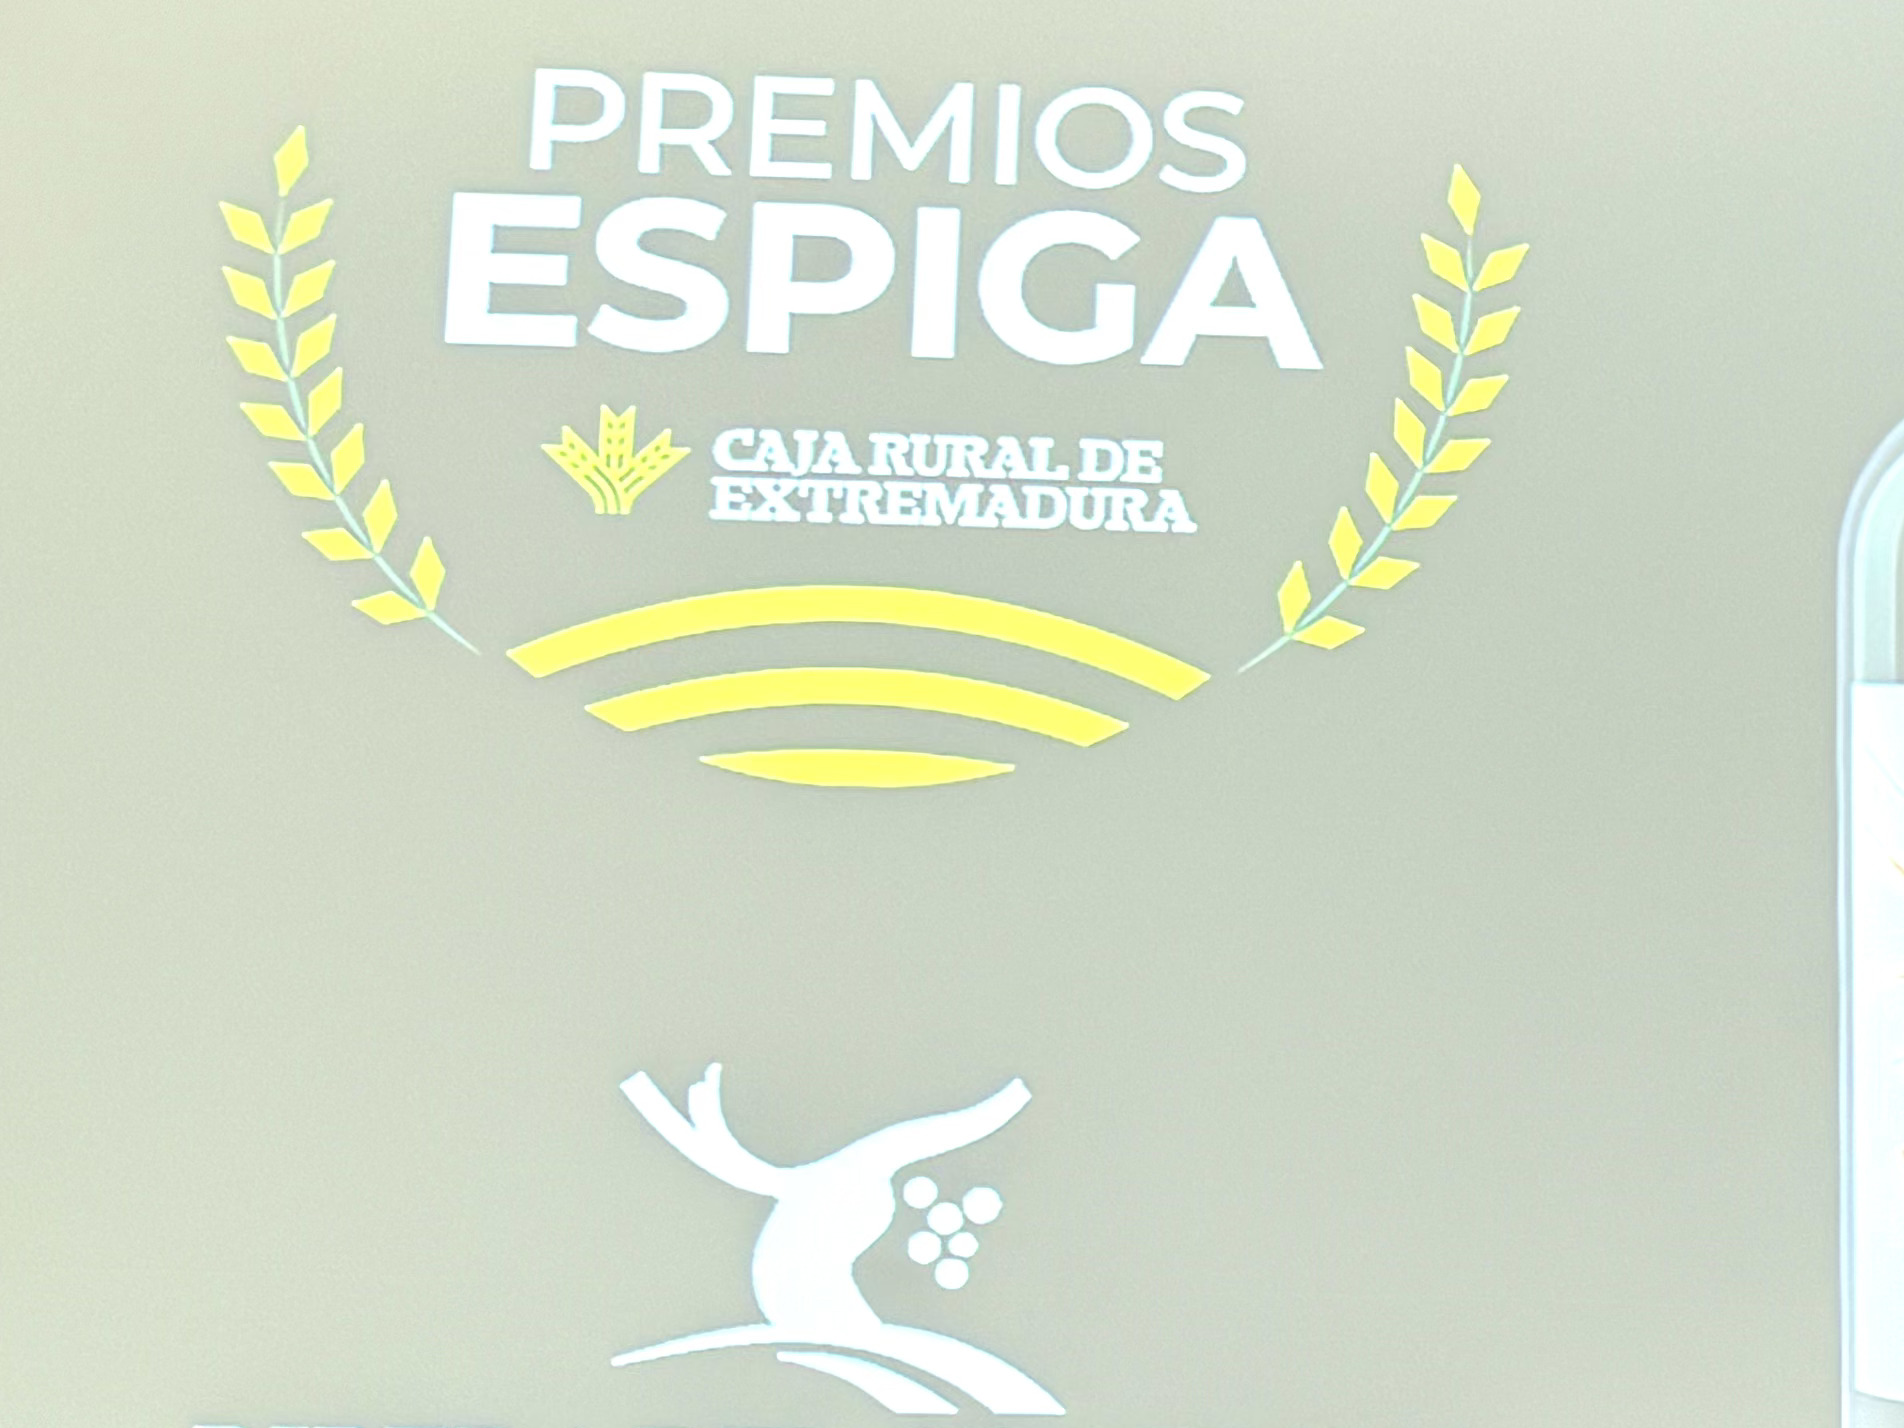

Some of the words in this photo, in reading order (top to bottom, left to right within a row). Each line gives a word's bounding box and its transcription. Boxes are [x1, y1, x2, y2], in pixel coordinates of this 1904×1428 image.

[530, 69, 1245, 192] PREMIOS
[443, 190, 1323, 370] ESPIGA
[711, 428, 862, 478] CAJA
[867, 432, 1070, 482] RURAL
[1077, 438, 1164, 484] DE
[708, 476, 1199, 534] EXTREMADURA
